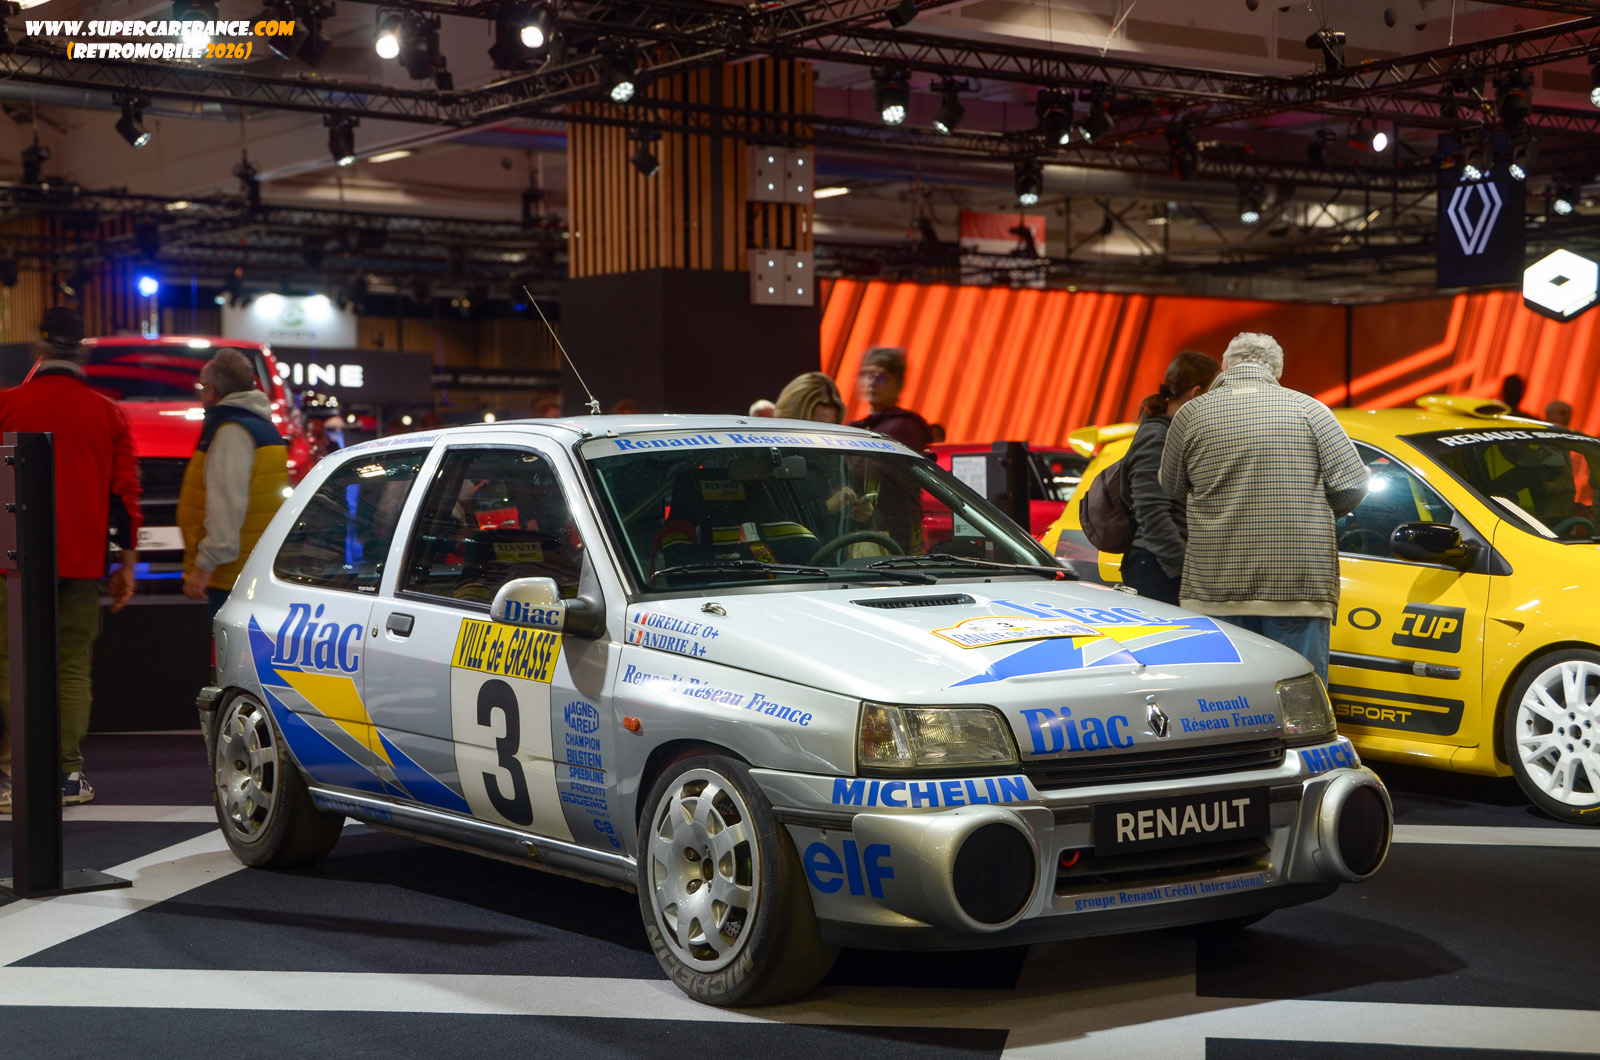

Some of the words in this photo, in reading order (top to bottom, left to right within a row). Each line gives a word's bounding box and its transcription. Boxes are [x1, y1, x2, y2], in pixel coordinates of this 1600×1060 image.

[612, 433, 722, 451] Renault
[727, 433, 812, 446] Réseau
[818, 435, 897, 451] France
[1436, 431, 1533, 447] RENAULT
[503, 600, 560, 626] Diac
[647, 613, 703, 636] OREILLE
[1394, 612, 1459, 640] CUP
[272, 603, 363, 673] Diac
[457, 621, 492, 669] VILLE
[486, 627, 504, 673] de
[504, 627, 557, 680] GRASSE
[642, 631, 690, 654] ANDRIE
[688, 642, 707, 657] A+
[622, 664, 683, 693] Renault
[682, 677, 744, 707] Réseau
[745, 692, 814, 727] France
[1197, 695, 1250, 714] Renault
[564, 701, 600, 720] MAGNETI
[1180, 714, 1230, 733] Réseau
[1234, 711, 1276, 729] France
[1336, 703, 1412, 723] SPORT
[564, 714, 600, 734] MARELLI
[1019, 706, 1134, 756] Diac
[477, 679, 534, 826] 3
[565, 733, 601, 751] CHAMPION
[566, 748, 602, 768] BILSTEIN
[1301, 740, 1356, 773] MICH
[569, 766, 604, 784] SPEEDLINE
[560, 791, 608, 810] SODEMO
[570, 782, 606, 797] FACOM
[832, 776, 1030, 808] MICHELIN
[1116, 798, 1251, 843] RENAULT
[803, 840, 895, 898] elf
[1075, 896, 1116, 911] groupe
[1119, 888, 1163, 904] Renault
[1164, 883, 1198, 898] Crédit
[1200, 873, 1265, 893] International
[645, 924, 755, 996] MICHELIN
